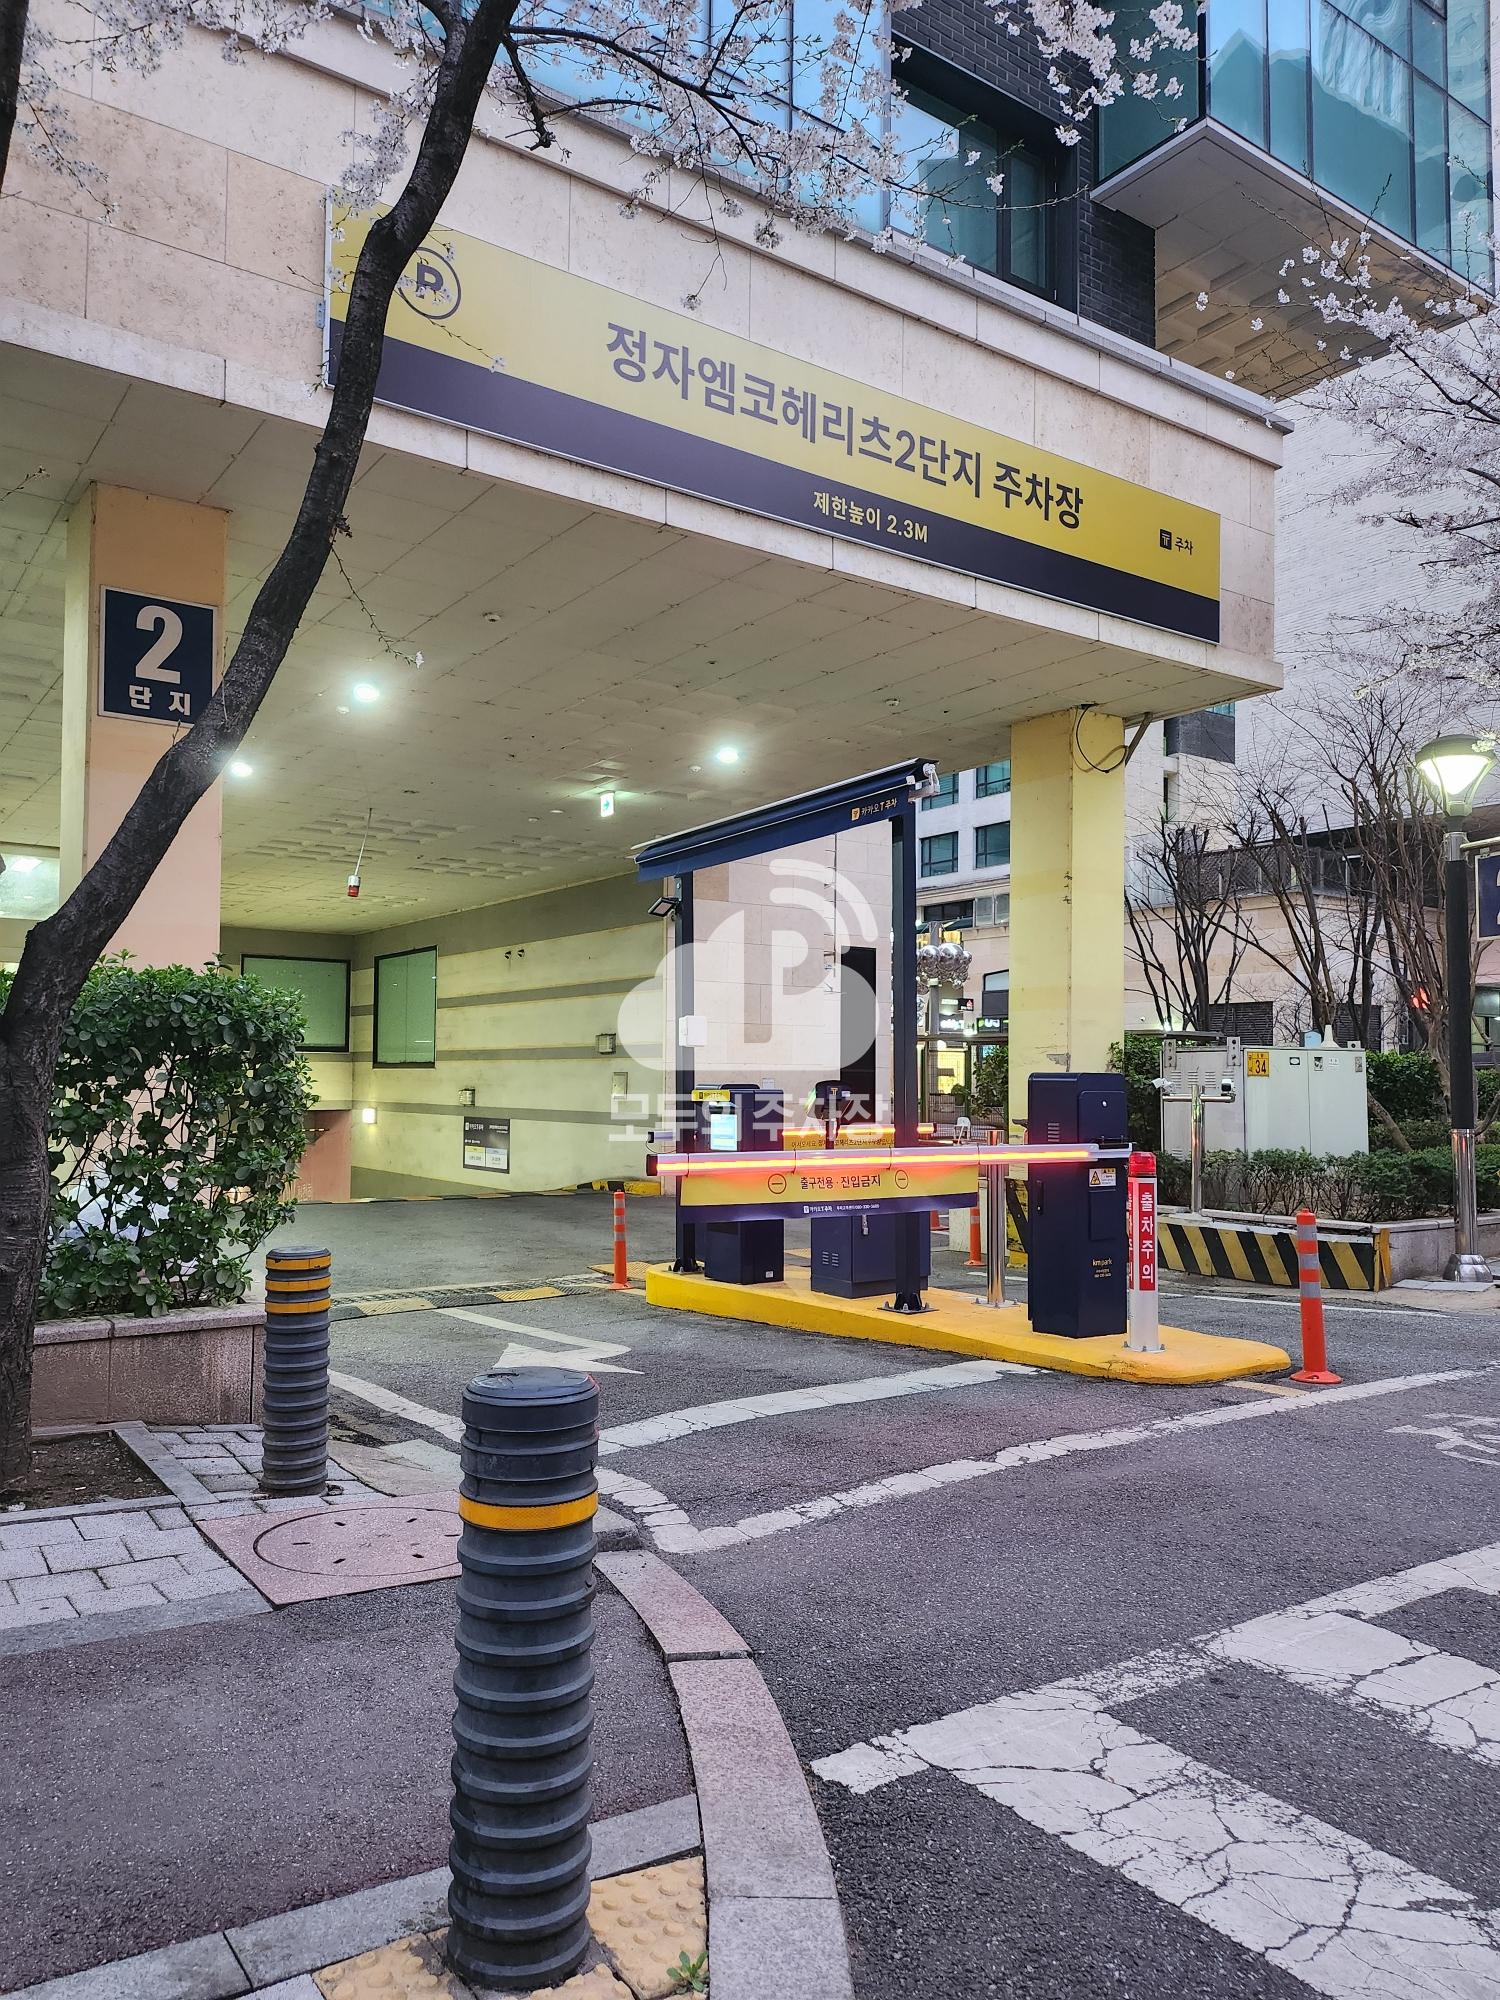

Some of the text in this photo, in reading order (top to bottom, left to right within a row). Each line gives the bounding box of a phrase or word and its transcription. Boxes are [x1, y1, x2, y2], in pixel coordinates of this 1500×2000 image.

[416, 262, 444, 299] P
[606, 322, 1084, 529] 정자엠코헤리츠2단지 주차장
[813, 490, 929, 544] 제한높이 2.3M
[1174, 537, 1194, 556] 주차
[134, 605, 184, 685] 2
[1255, 1059, 1267, 1074] 34
[800, 1174, 881, 1190] 출구전용 진입금지
[1140, 1192, 1154, 1284] 출차주의
